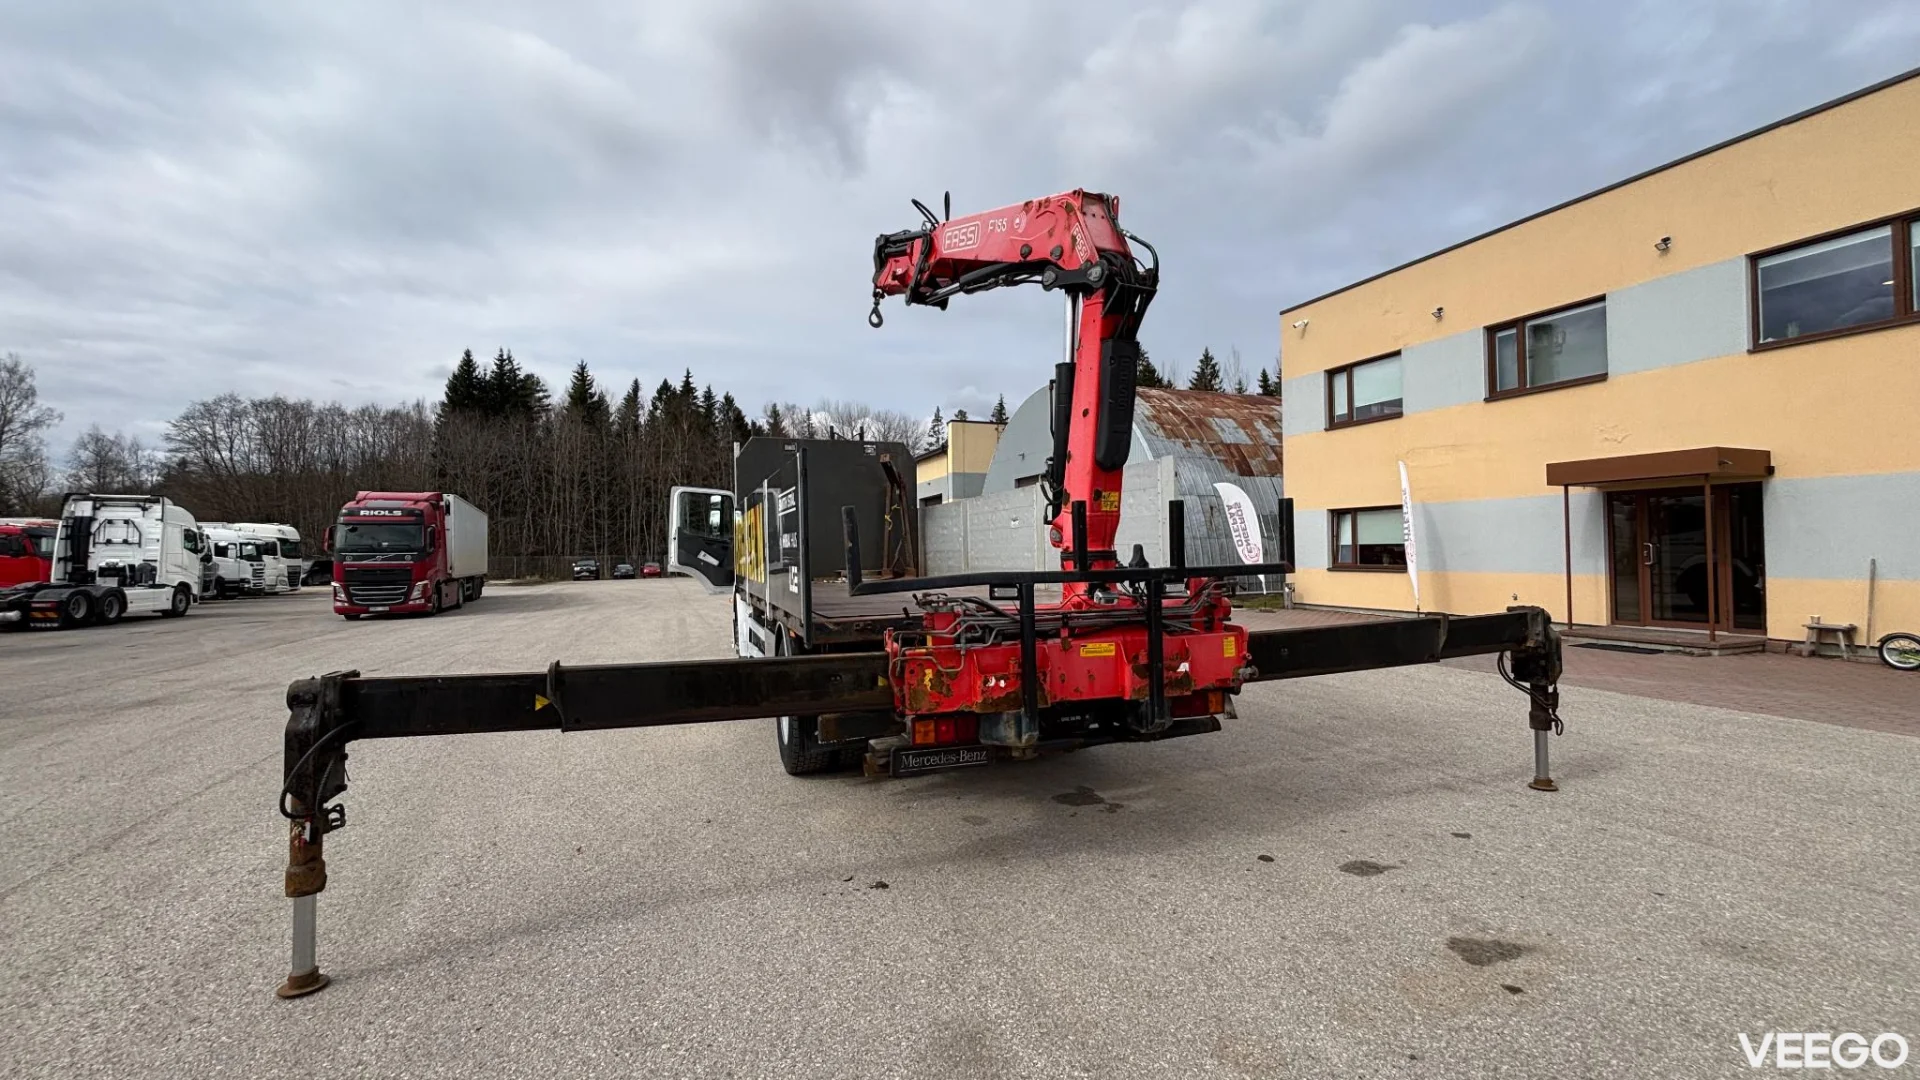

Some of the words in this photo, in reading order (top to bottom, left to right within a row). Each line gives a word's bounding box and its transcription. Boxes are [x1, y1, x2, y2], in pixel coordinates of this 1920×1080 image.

[945, 226, 978, 249] FASSI
[1073, 228, 1088, 260] FASSI
[901, 750, 987, 768] Mercedes-Benz
